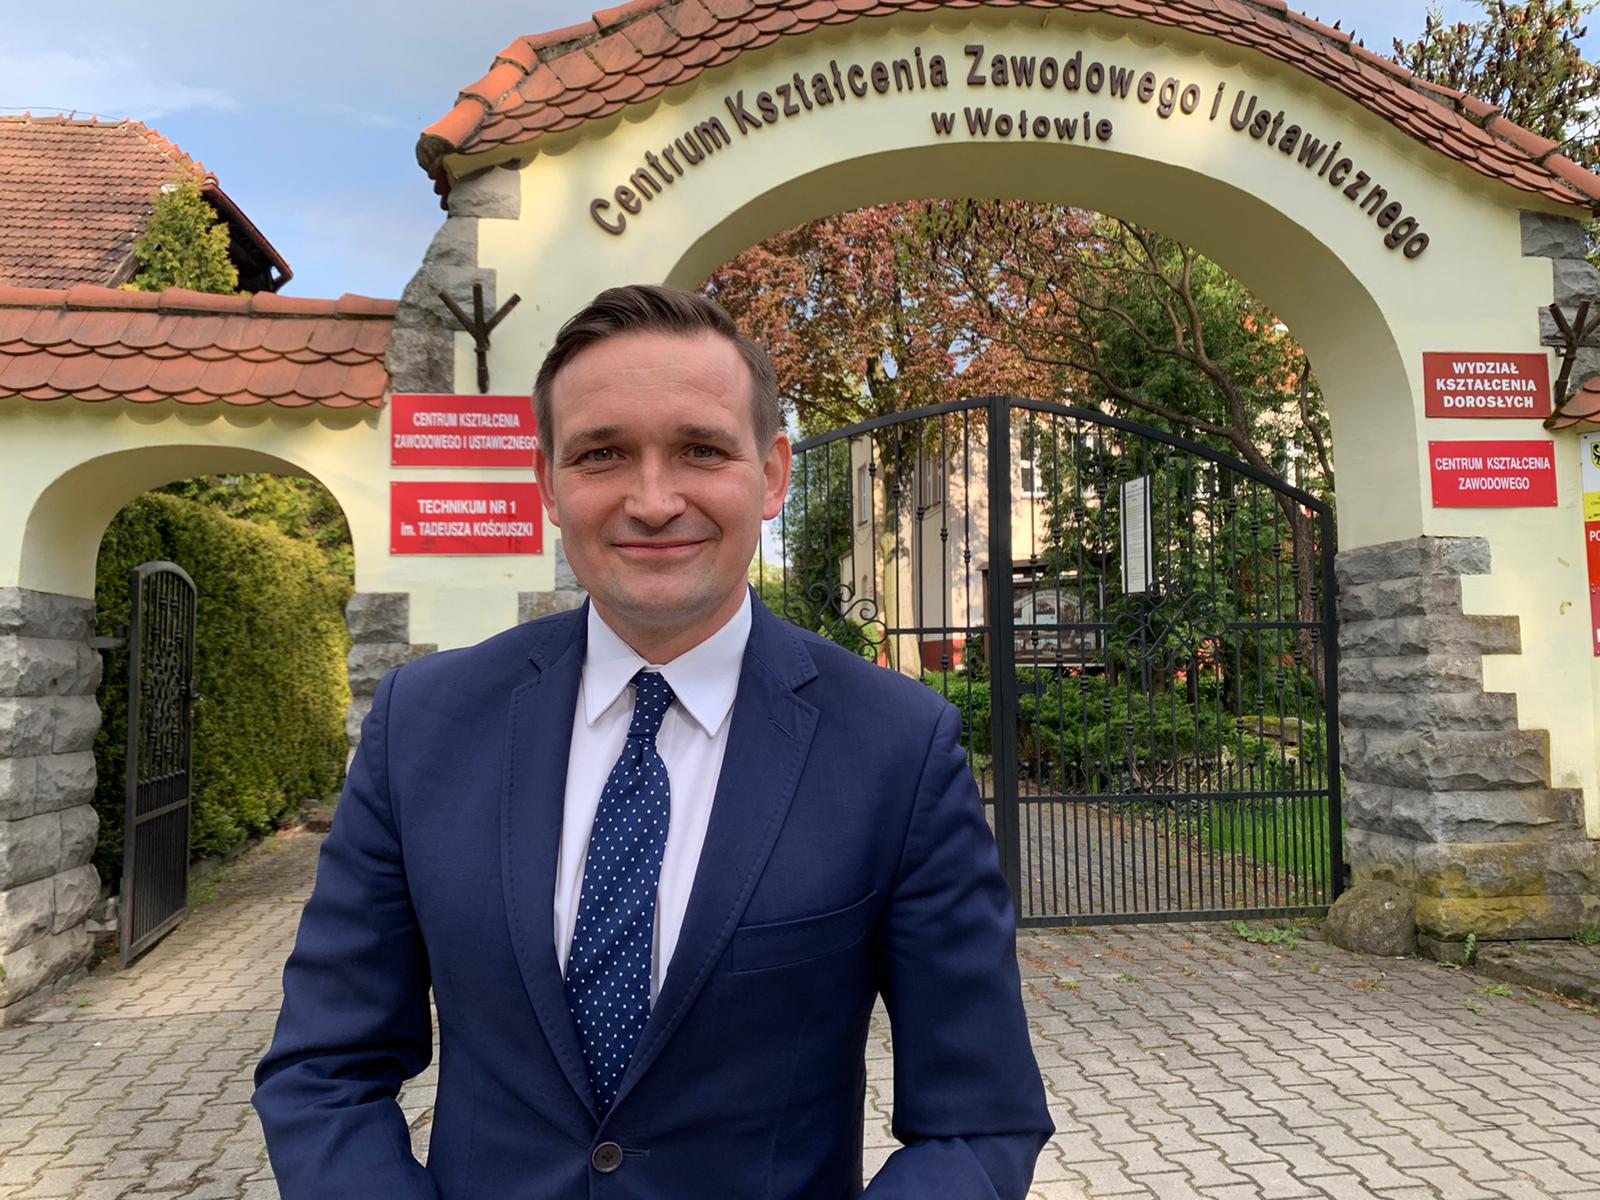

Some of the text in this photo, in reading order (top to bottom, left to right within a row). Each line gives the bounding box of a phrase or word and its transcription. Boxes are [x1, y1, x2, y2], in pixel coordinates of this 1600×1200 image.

[931, 107, 1114, 142] w Wołowie
[590, 44, 1431, 260] Centrum Kształcenia Zawodowego i Ustawicznego
[1452, 361, 1519, 375] WYDZIAŁ
[1436, 378, 1537, 392] KSZTAŁCENIA
[1443, 395, 1534, 409] DOROSŁYCH
[412, 412, 520, 428] CENTRUM KSZTAŁCENIA
[394, 434, 538, 450] ZAWODOWEGO I USTAWICZNEGO
[1435, 457, 1551, 471] CENTRUM KSZTAŁCENIA
[1458, 476, 1530, 491] ZAWODOWEGO
[417, 499, 516, 514] TECHNIKUM NR 1
[401, 519, 533, 537] im. TADEUSZA KOŚCIUSZKI
